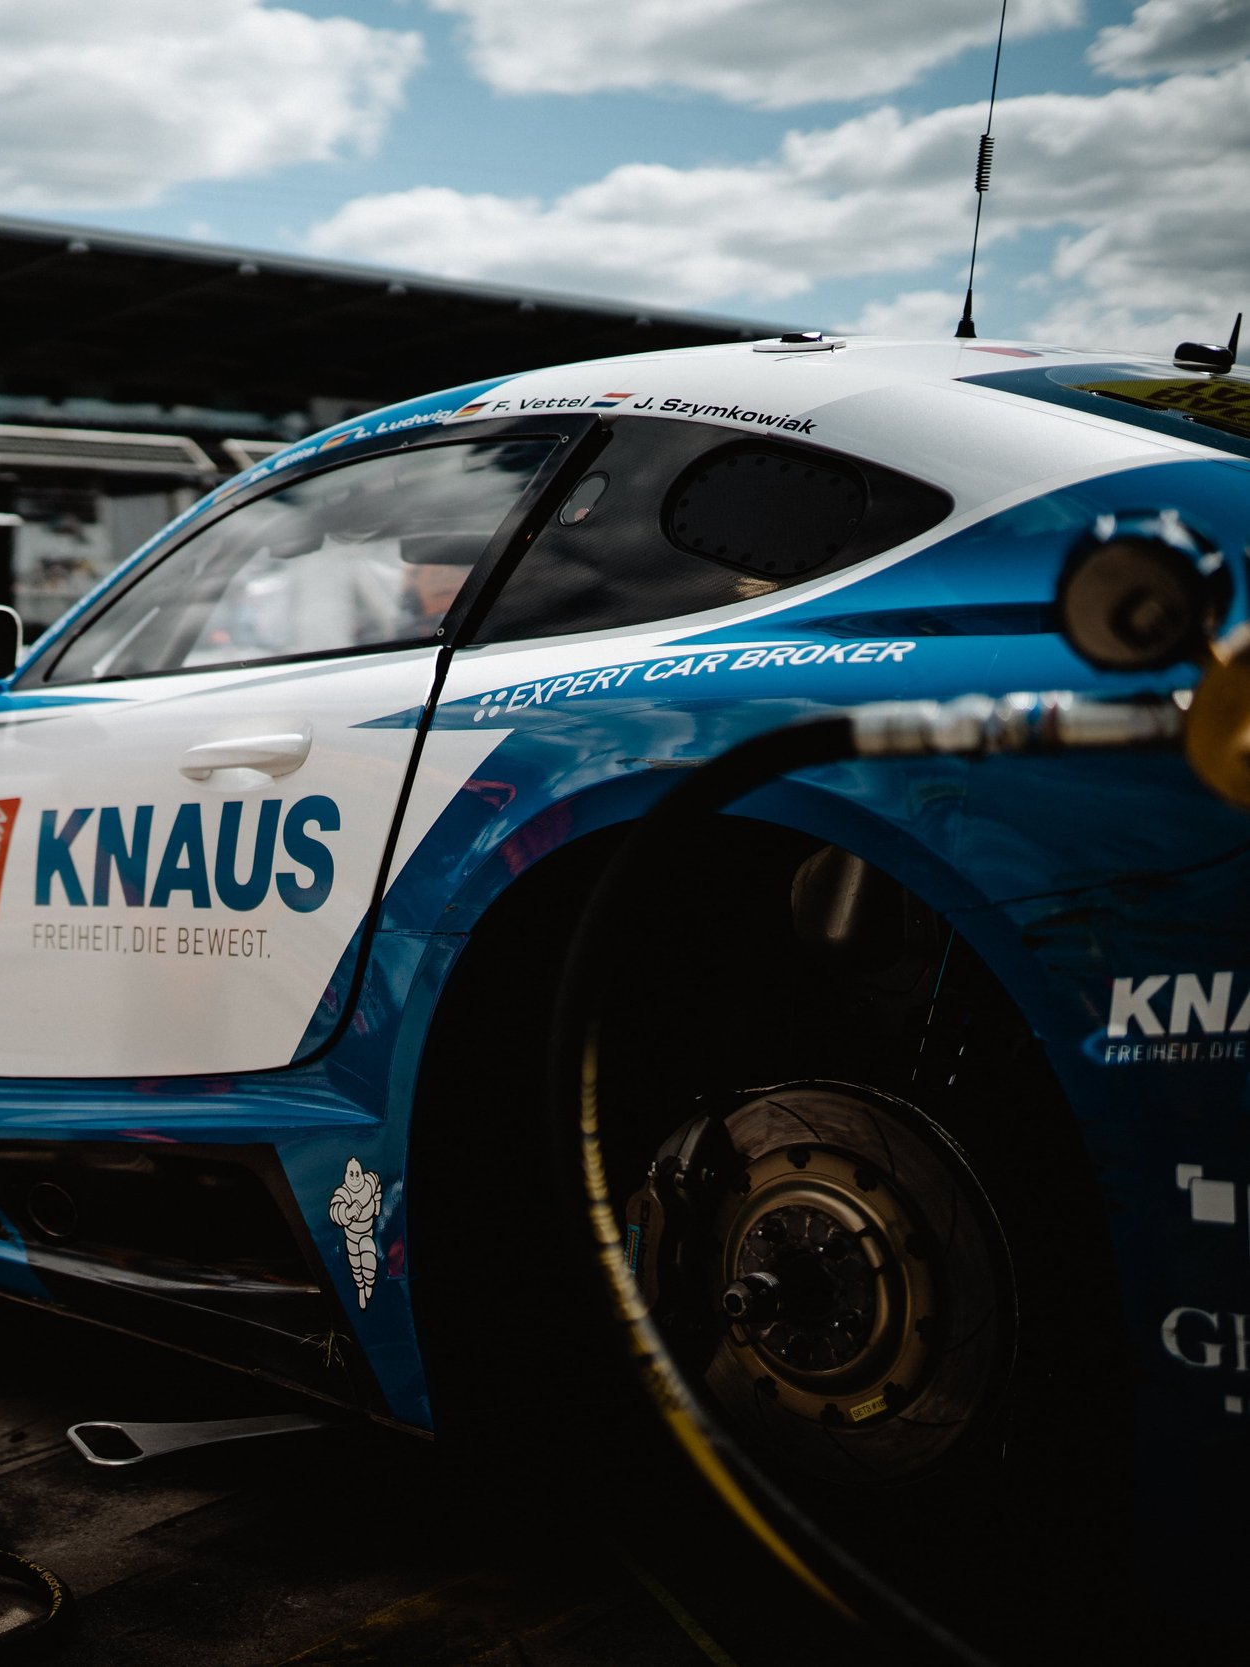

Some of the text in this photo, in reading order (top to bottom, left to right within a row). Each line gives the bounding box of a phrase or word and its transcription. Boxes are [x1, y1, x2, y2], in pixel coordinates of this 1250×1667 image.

[491, 395, 591, 413] F. Vettel
[633, 397, 818, 435] J. Szymkowiak
[504, 640, 918, 714] EXPERT CAR BROKER
[34, 794, 342, 914] KNAUS
[132, 926, 167, 954] DIE
[177, 927, 271, 959] BEWEGT.
[1208, 1040, 1248, 1061] DIE
